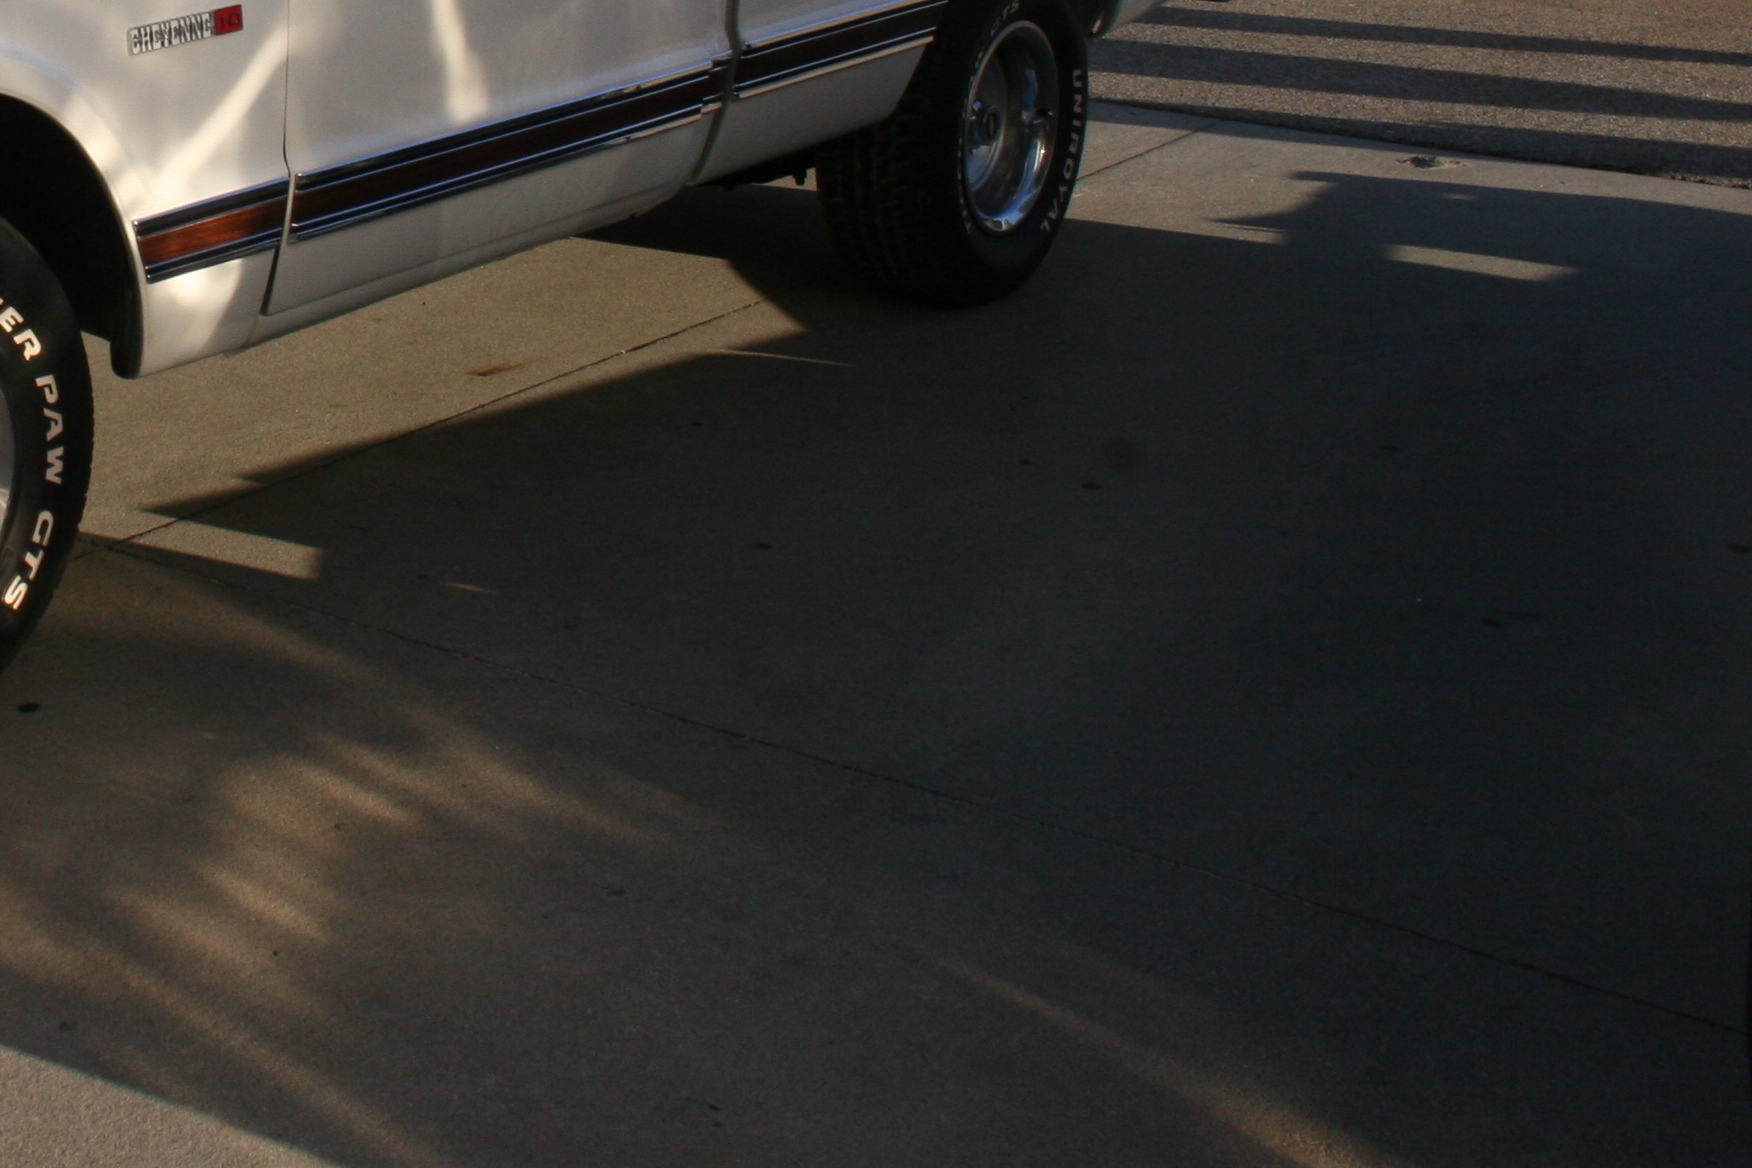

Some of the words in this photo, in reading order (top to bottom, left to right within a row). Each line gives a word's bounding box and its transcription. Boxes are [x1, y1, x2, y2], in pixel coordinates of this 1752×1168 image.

[128, 11, 213, 56] CHEYENNE
[1039, 68, 1084, 233] UNIROYAL
[34, 373, 66, 485] PAW
[0, 509, 55, 611] GTS
